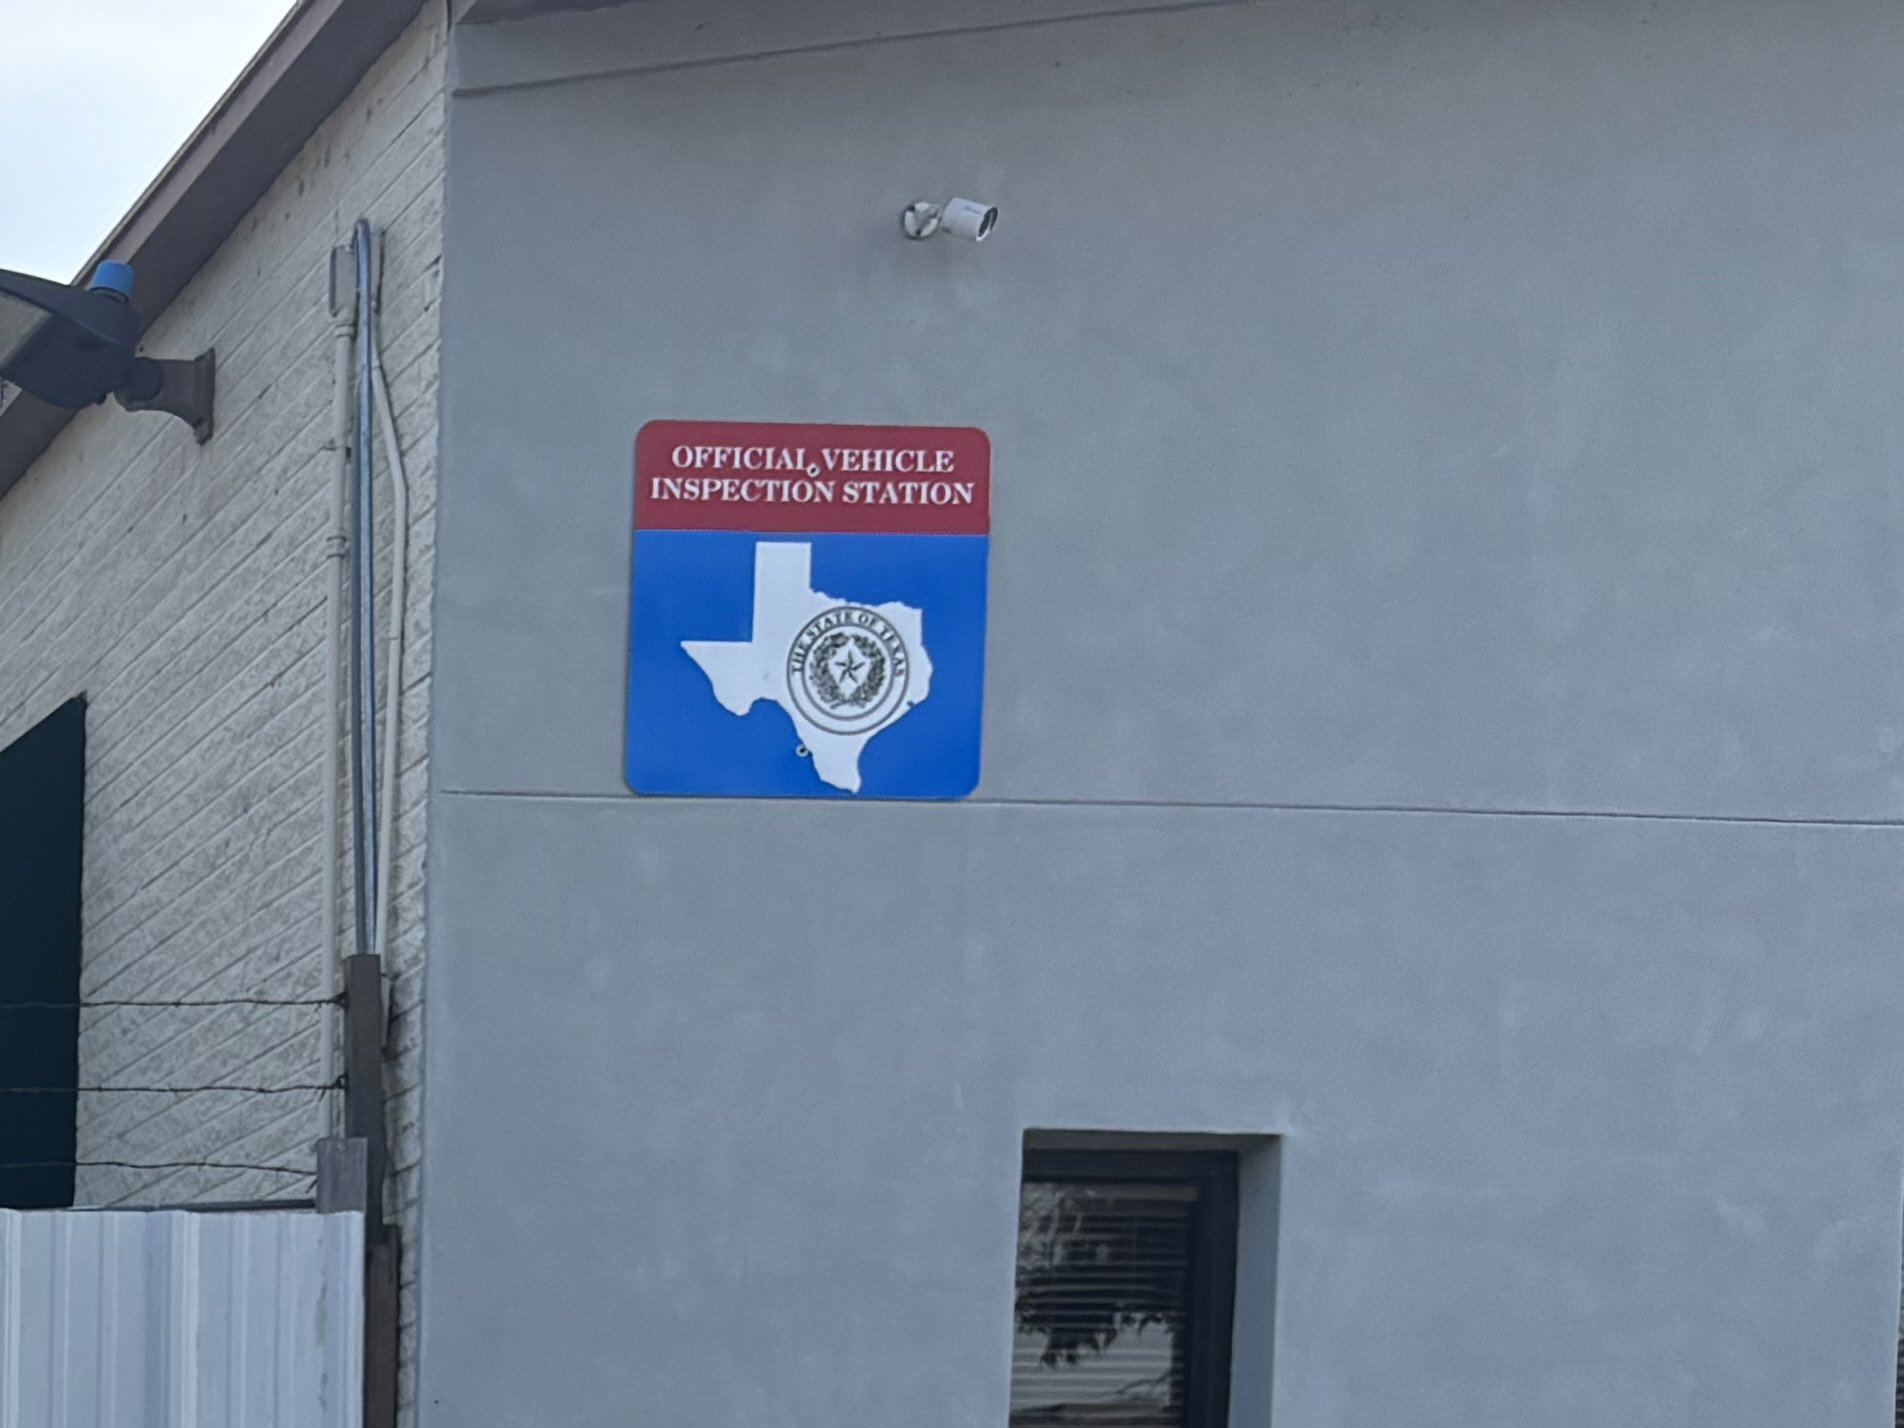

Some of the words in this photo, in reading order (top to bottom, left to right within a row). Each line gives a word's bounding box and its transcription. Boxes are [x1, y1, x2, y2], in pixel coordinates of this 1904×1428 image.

[672, 446, 809, 470] OFFICIAL
[822, 448, 954, 473] VEHICLE
[651, 477, 835, 502] INSPECTION
[842, 481, 975, 505] STATION
[792, 639, 808, 675] THE
[806, 611, 852, 639] STATE
[858, 613, 878, 628] OF
[879, 624, 905, 677] TEXAS
